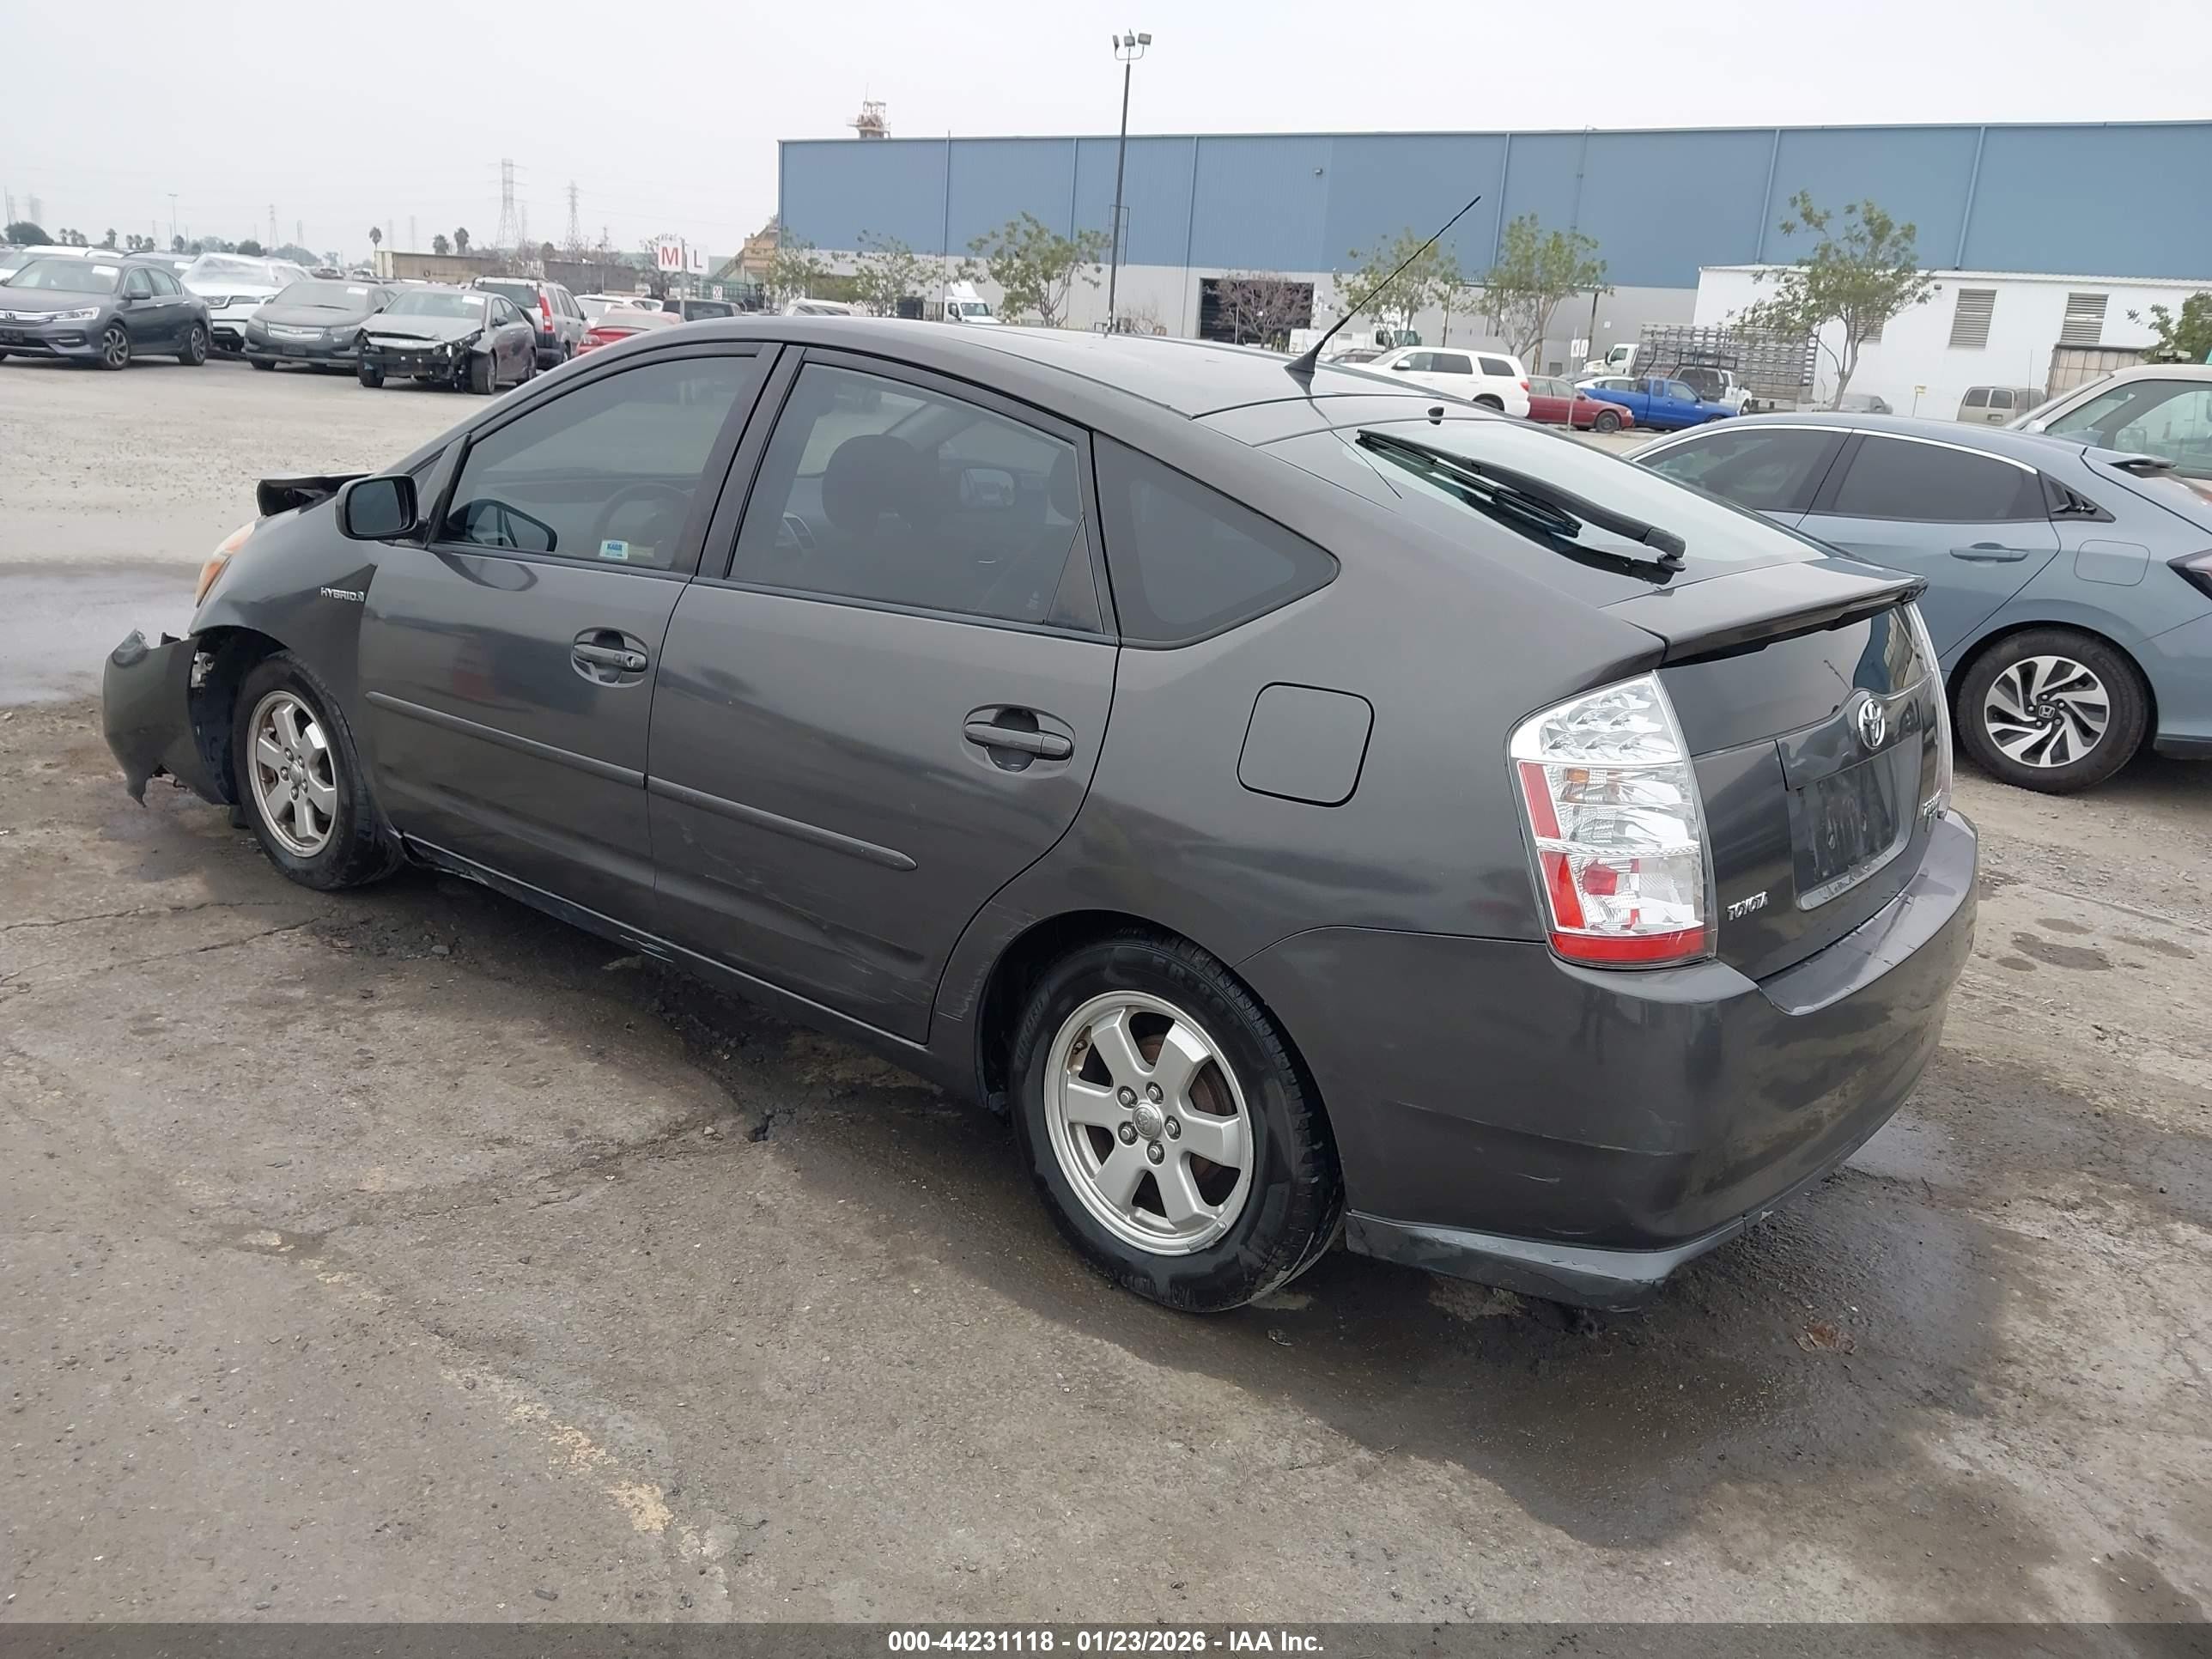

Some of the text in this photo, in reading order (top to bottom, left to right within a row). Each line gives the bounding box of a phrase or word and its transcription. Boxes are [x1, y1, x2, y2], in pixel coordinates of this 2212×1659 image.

[661, 246, 678, 266] M
[693, 249, 703, 269] L
[320, 586, 357, 601] HYBRID
[1726, 891, 1768, 921] TOYOTA
